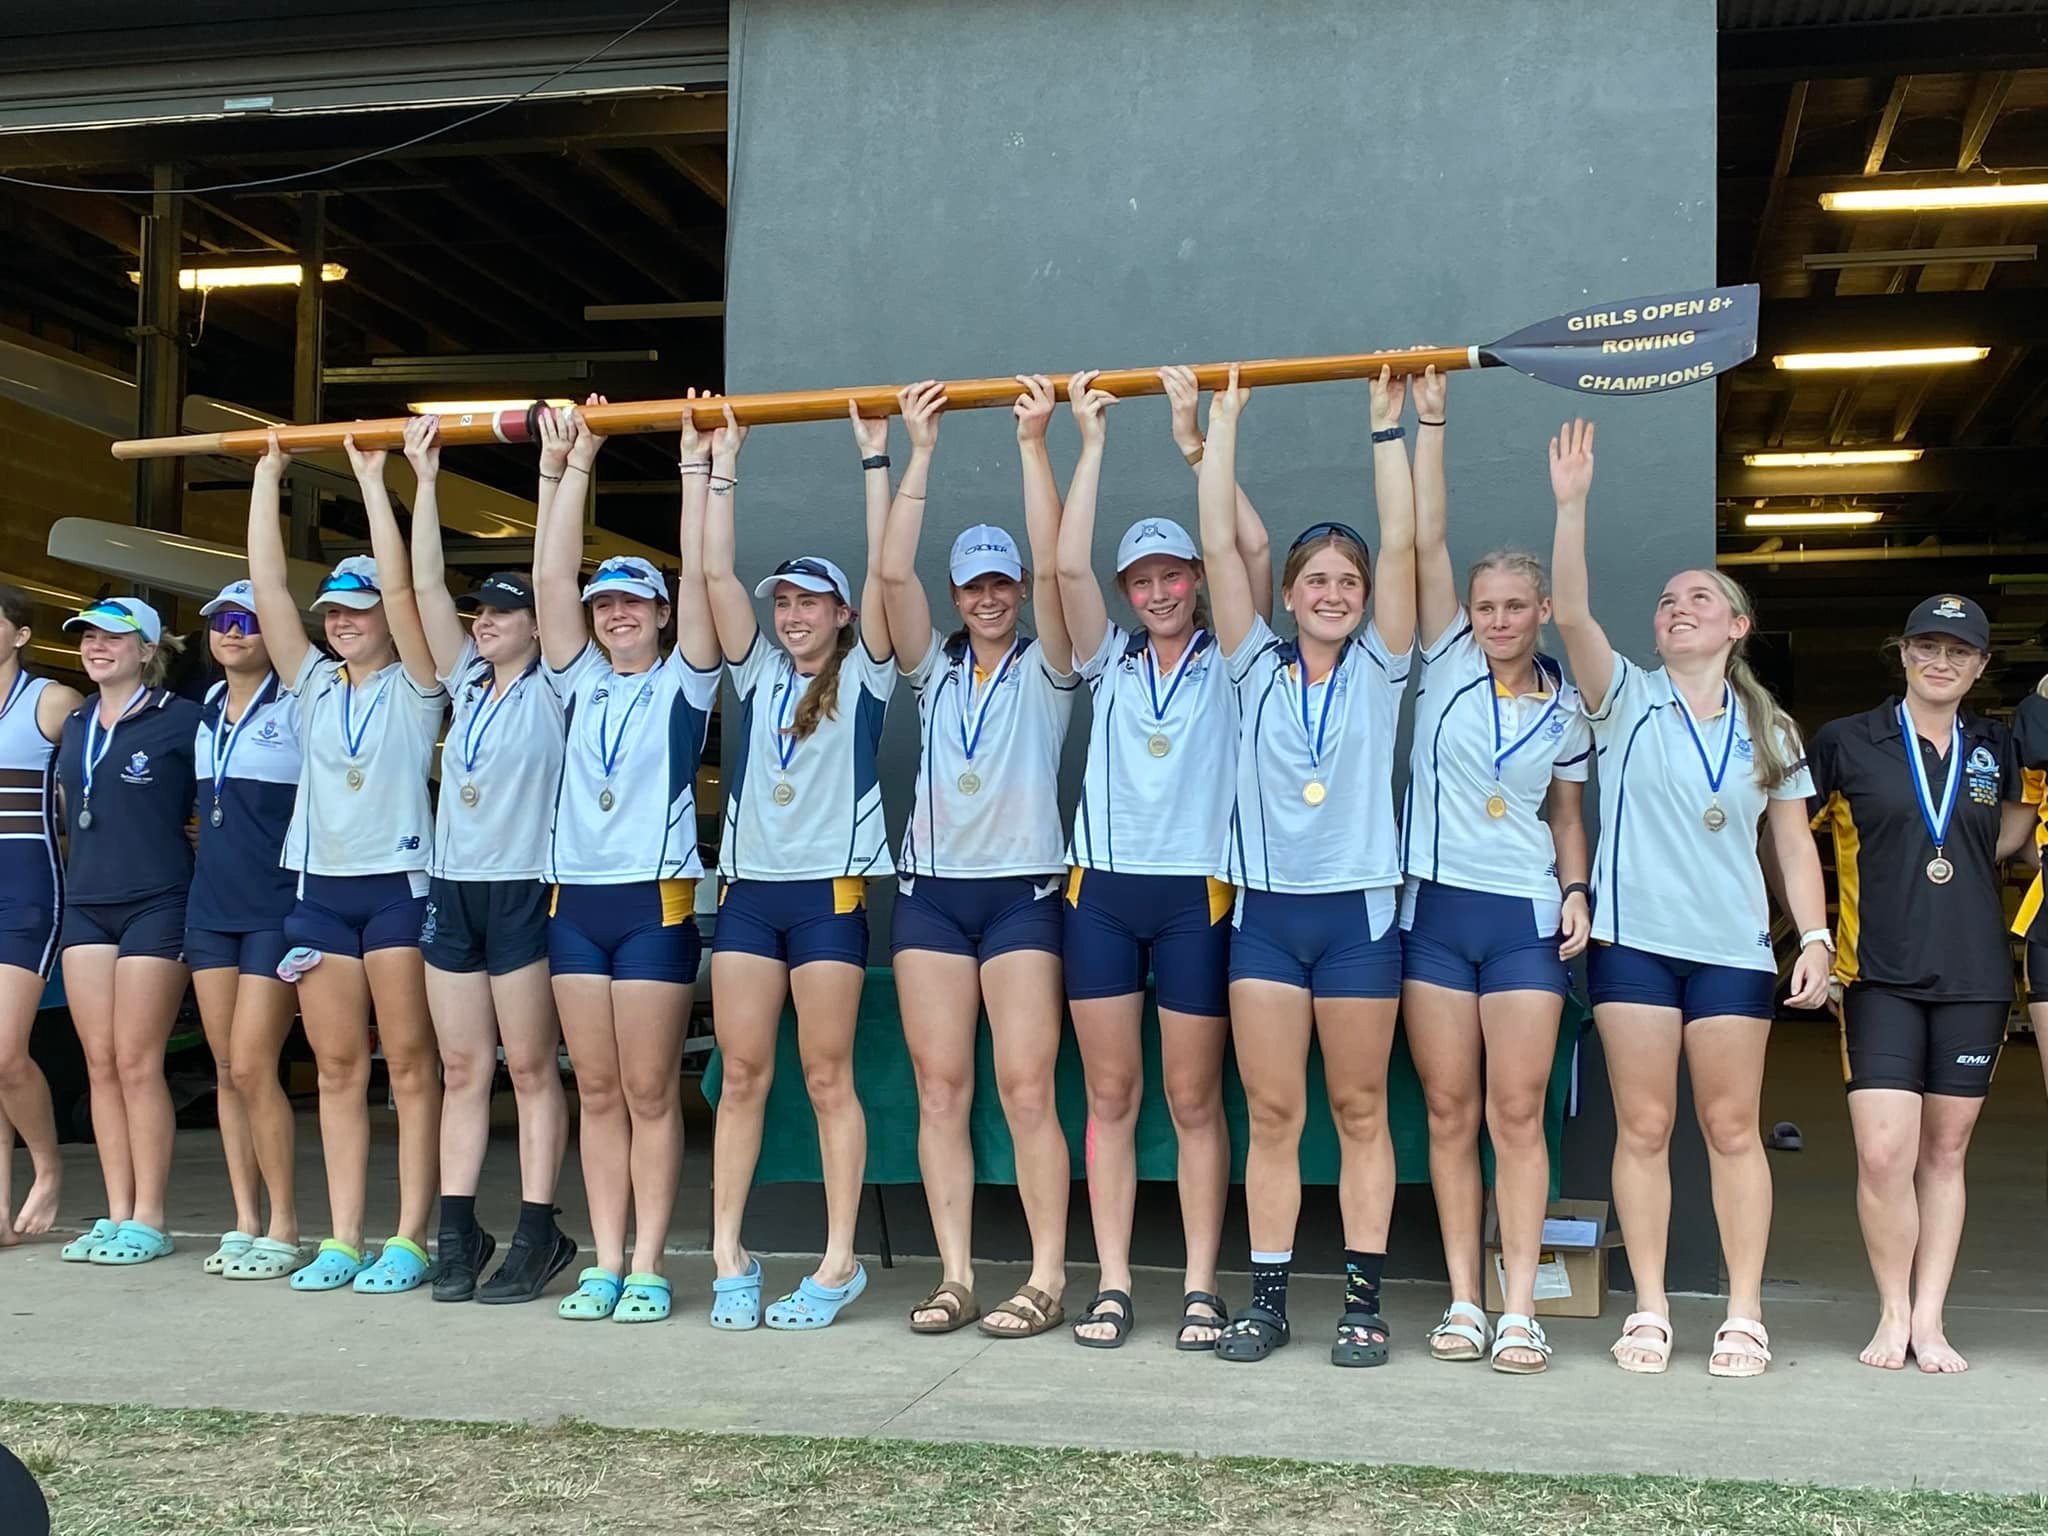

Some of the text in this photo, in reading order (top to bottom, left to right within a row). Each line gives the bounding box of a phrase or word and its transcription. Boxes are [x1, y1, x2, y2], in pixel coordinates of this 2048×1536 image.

[1567, 296, 1734, 331] GIRLS OPEN 8+
[1601, 330, 1696, 354] ROWING
[1578, 361, 1715, 391] CHAMPIONS
[1956, 1054, 1991, 1064] EMU
